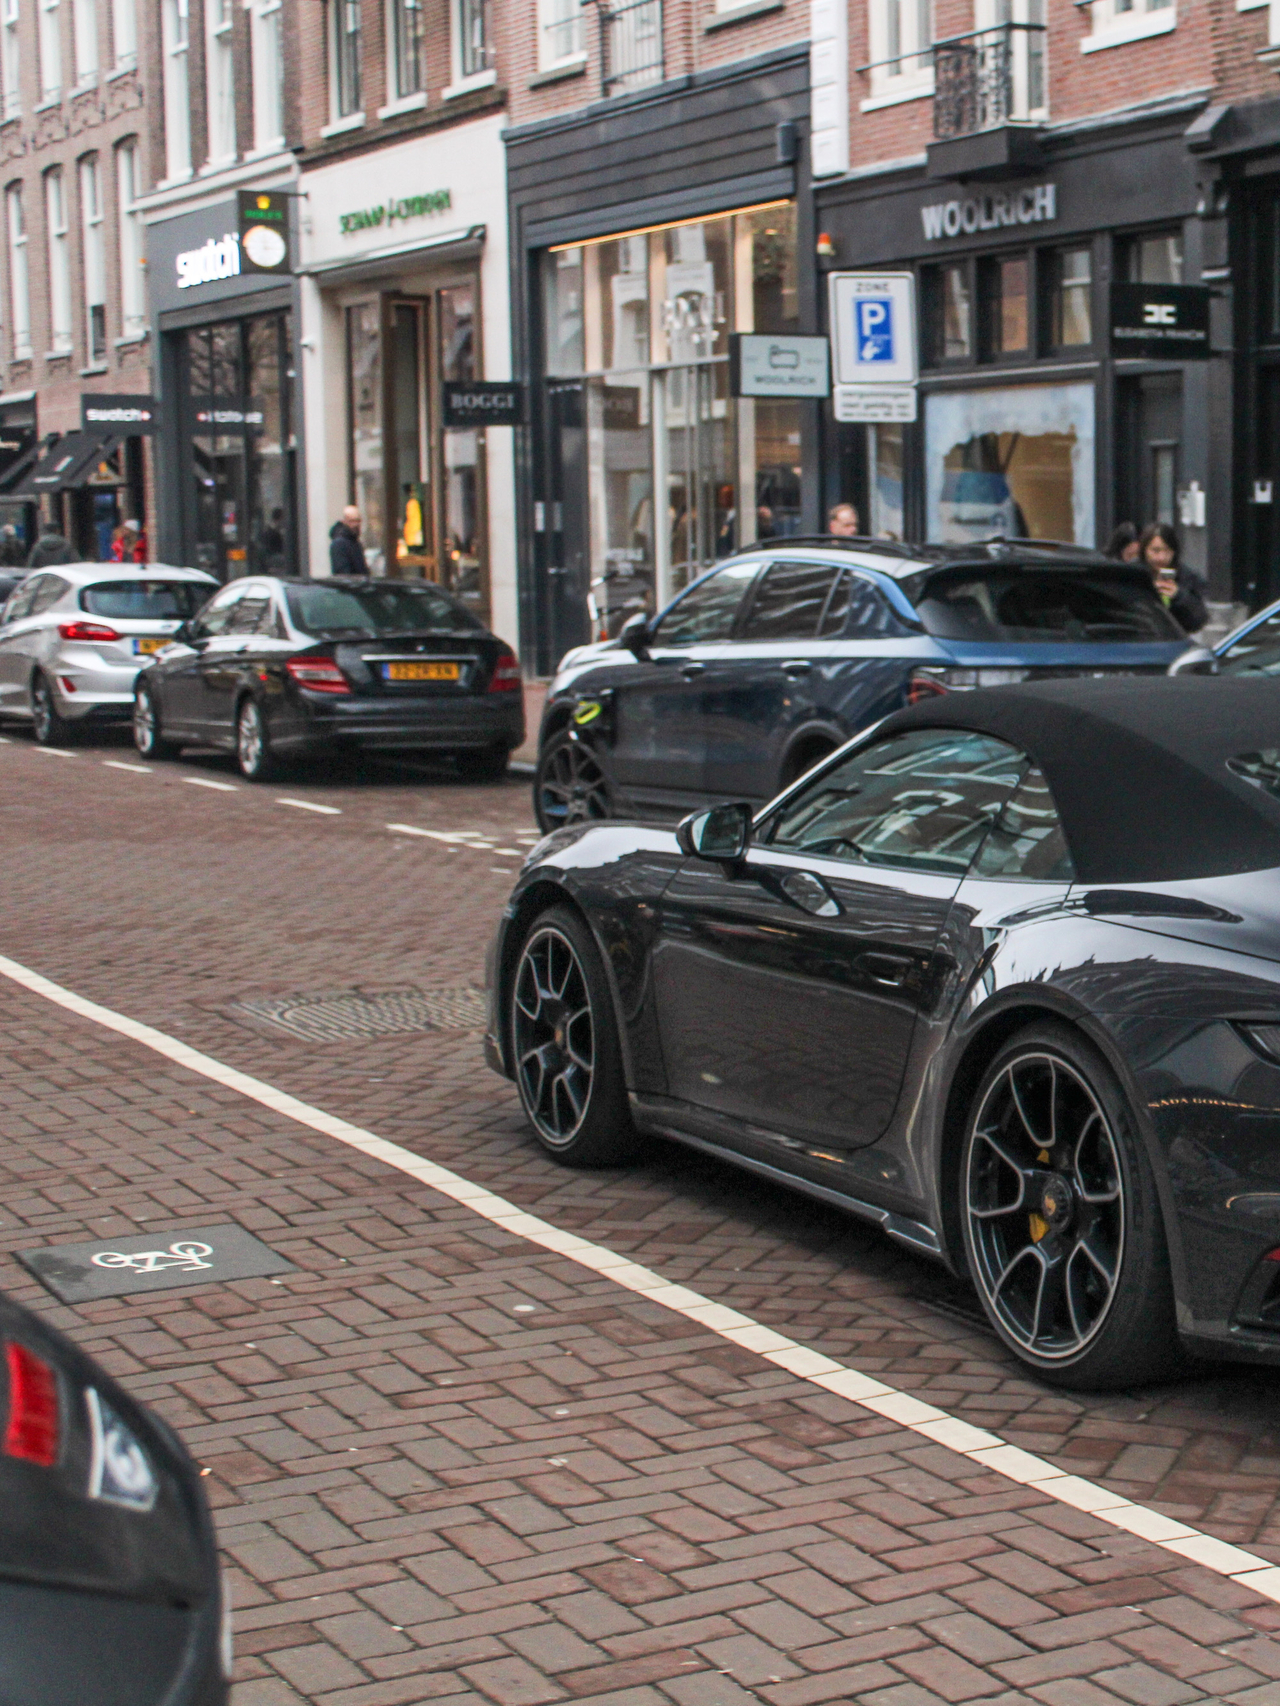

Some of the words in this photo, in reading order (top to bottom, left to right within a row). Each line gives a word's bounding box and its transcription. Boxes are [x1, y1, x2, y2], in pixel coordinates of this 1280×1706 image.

[921, 183, 1056, 240] WOOLRICH
[856, 282, 890, 293] ZONE
[861, 302, 887, 337] P
[450, 392, 515, 410] BOGGI
